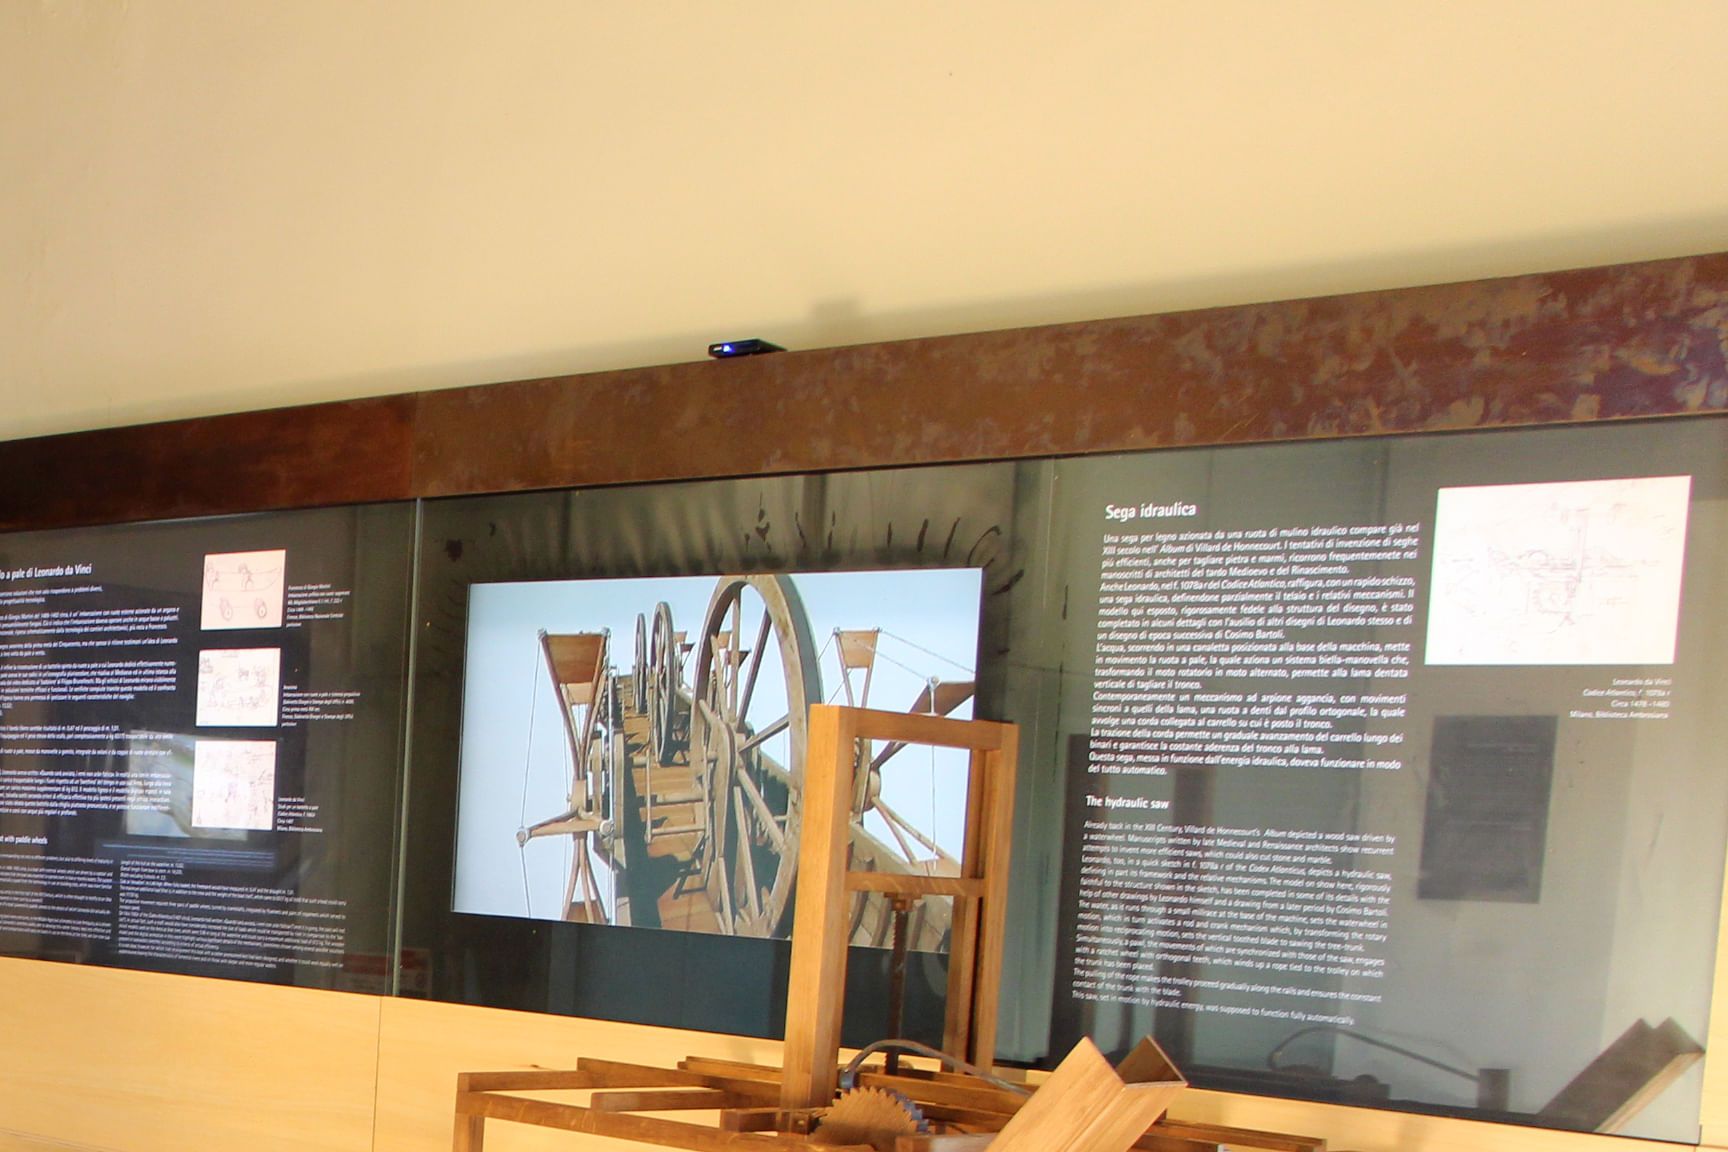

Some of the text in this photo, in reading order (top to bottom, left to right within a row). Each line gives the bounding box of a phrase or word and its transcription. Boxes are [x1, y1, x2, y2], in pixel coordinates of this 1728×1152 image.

[1104, 501, 1197, 522] Sega idraulica
[1103, 533, 1119, 543] Una
[1121, 535, 1138, 545] sega
[1140, 535, 1153, 545] per
[1155, 531, 1177, 544] legno
[1179, 531, 1212, 541] azionata
[1227, 531, 1243, 539] una
[1245, 529, 1267, 538] ruota
[1279, 526, 1309, 537] mulino
[1310, 525, 1348, 536] idraulico
[1349, 526, 1387, 537] compare
[1405, 522, 1420, 533] nel
[1102, 546, 1116, 555] XIII
[1117, 545, 1141, 555] secolo
[1160, 543, 1185, 554] Album
[1195, 542, 1221, 552] Villard
[1233, 540, 1281, 551] Honnecourt.
[1289, 539, 1324, 549] tentativi
[1335, 537, 1381, 548] invenzione
[1393, 535, 1419, 549] seghe
[1116, 557, 1151, 568] efficienti,
[1153, 556, 1177, 566] anche
[1178, 558, 1191, 568] per
[1193, 554, 1224, 568] tagliare
[1225, 554, 1249, 567] pietra
[1258, 553, 1286, 564] marmi,
[1289, 552, 1327, 562] ricorrono
[1403, 549, 1418, 559] nei
[6, 572, 10, 580] a
[12, 569, 25, 580] pale
[26, 568, 33, 578] di
[34, 566, 64, 578] Leonardo
[64, 566, 73, 576] da
[74, 564, 92, 575] Vinci
[1101, 570, 1143, 580] manoscritti
[1154, 568, 1190, 578] architetti
[1191, 567, 1204, 577] del
[1205, 567, 1227, 577] tardo
[1228, 566, 1268, 576] Medioevo
[1276, 565, 1290, 575] del
[1291, 563, 1350, 575] Rinascimento.
[1098, 606, 1129, 616] modello
[1131, 607, 1144, 618] qui
[1146, 607, 1178, 618] esposto,
[1180, 605, 1237, 617] rigorosamente
[1240, 604, 1265, 614] fedele
[1268, 603, 1284, 613] alla
[1286, 604, 1324, 613] struttura
[1326, 602, 1340, 612] del
[1343, 602, 1377, 615] disegno,
[1391, 602, 1414, 611] stato
[1096, 643, 1125, 655] L'acqua,
[1128, 642, 1165, 652] scorrendo
[1192, 642, 1230, 652] canaletta
[1231, 642, 1277, 654] posizionata
[1279, 641, 1295, 651] alla
[1295, 641, 1315, 651] base
[1317, 641, 1338, 651] della
[1339, 640, 1381, 652] macchina,
[1384, 642, 1411, 651] mette
[1093, 679, 1126, 688] verticale
[1136, 679, 1166, 691] tagliare
[1174, 681, 1202, 689] tronco.
[1092, 691, 1176, 703] Contemporaneamente
[1194, 692, 1243, 701] meccanismo
[1261, 693, 1292, 705] arpione
[1296, 693, 1335, 705] aggancia,
[1361, 693, 1407, 703] movimenti
[1088, 763, 1168, 775] del tutto automatico.
[1086, 794, 1170, 810] The hydraulic saw
